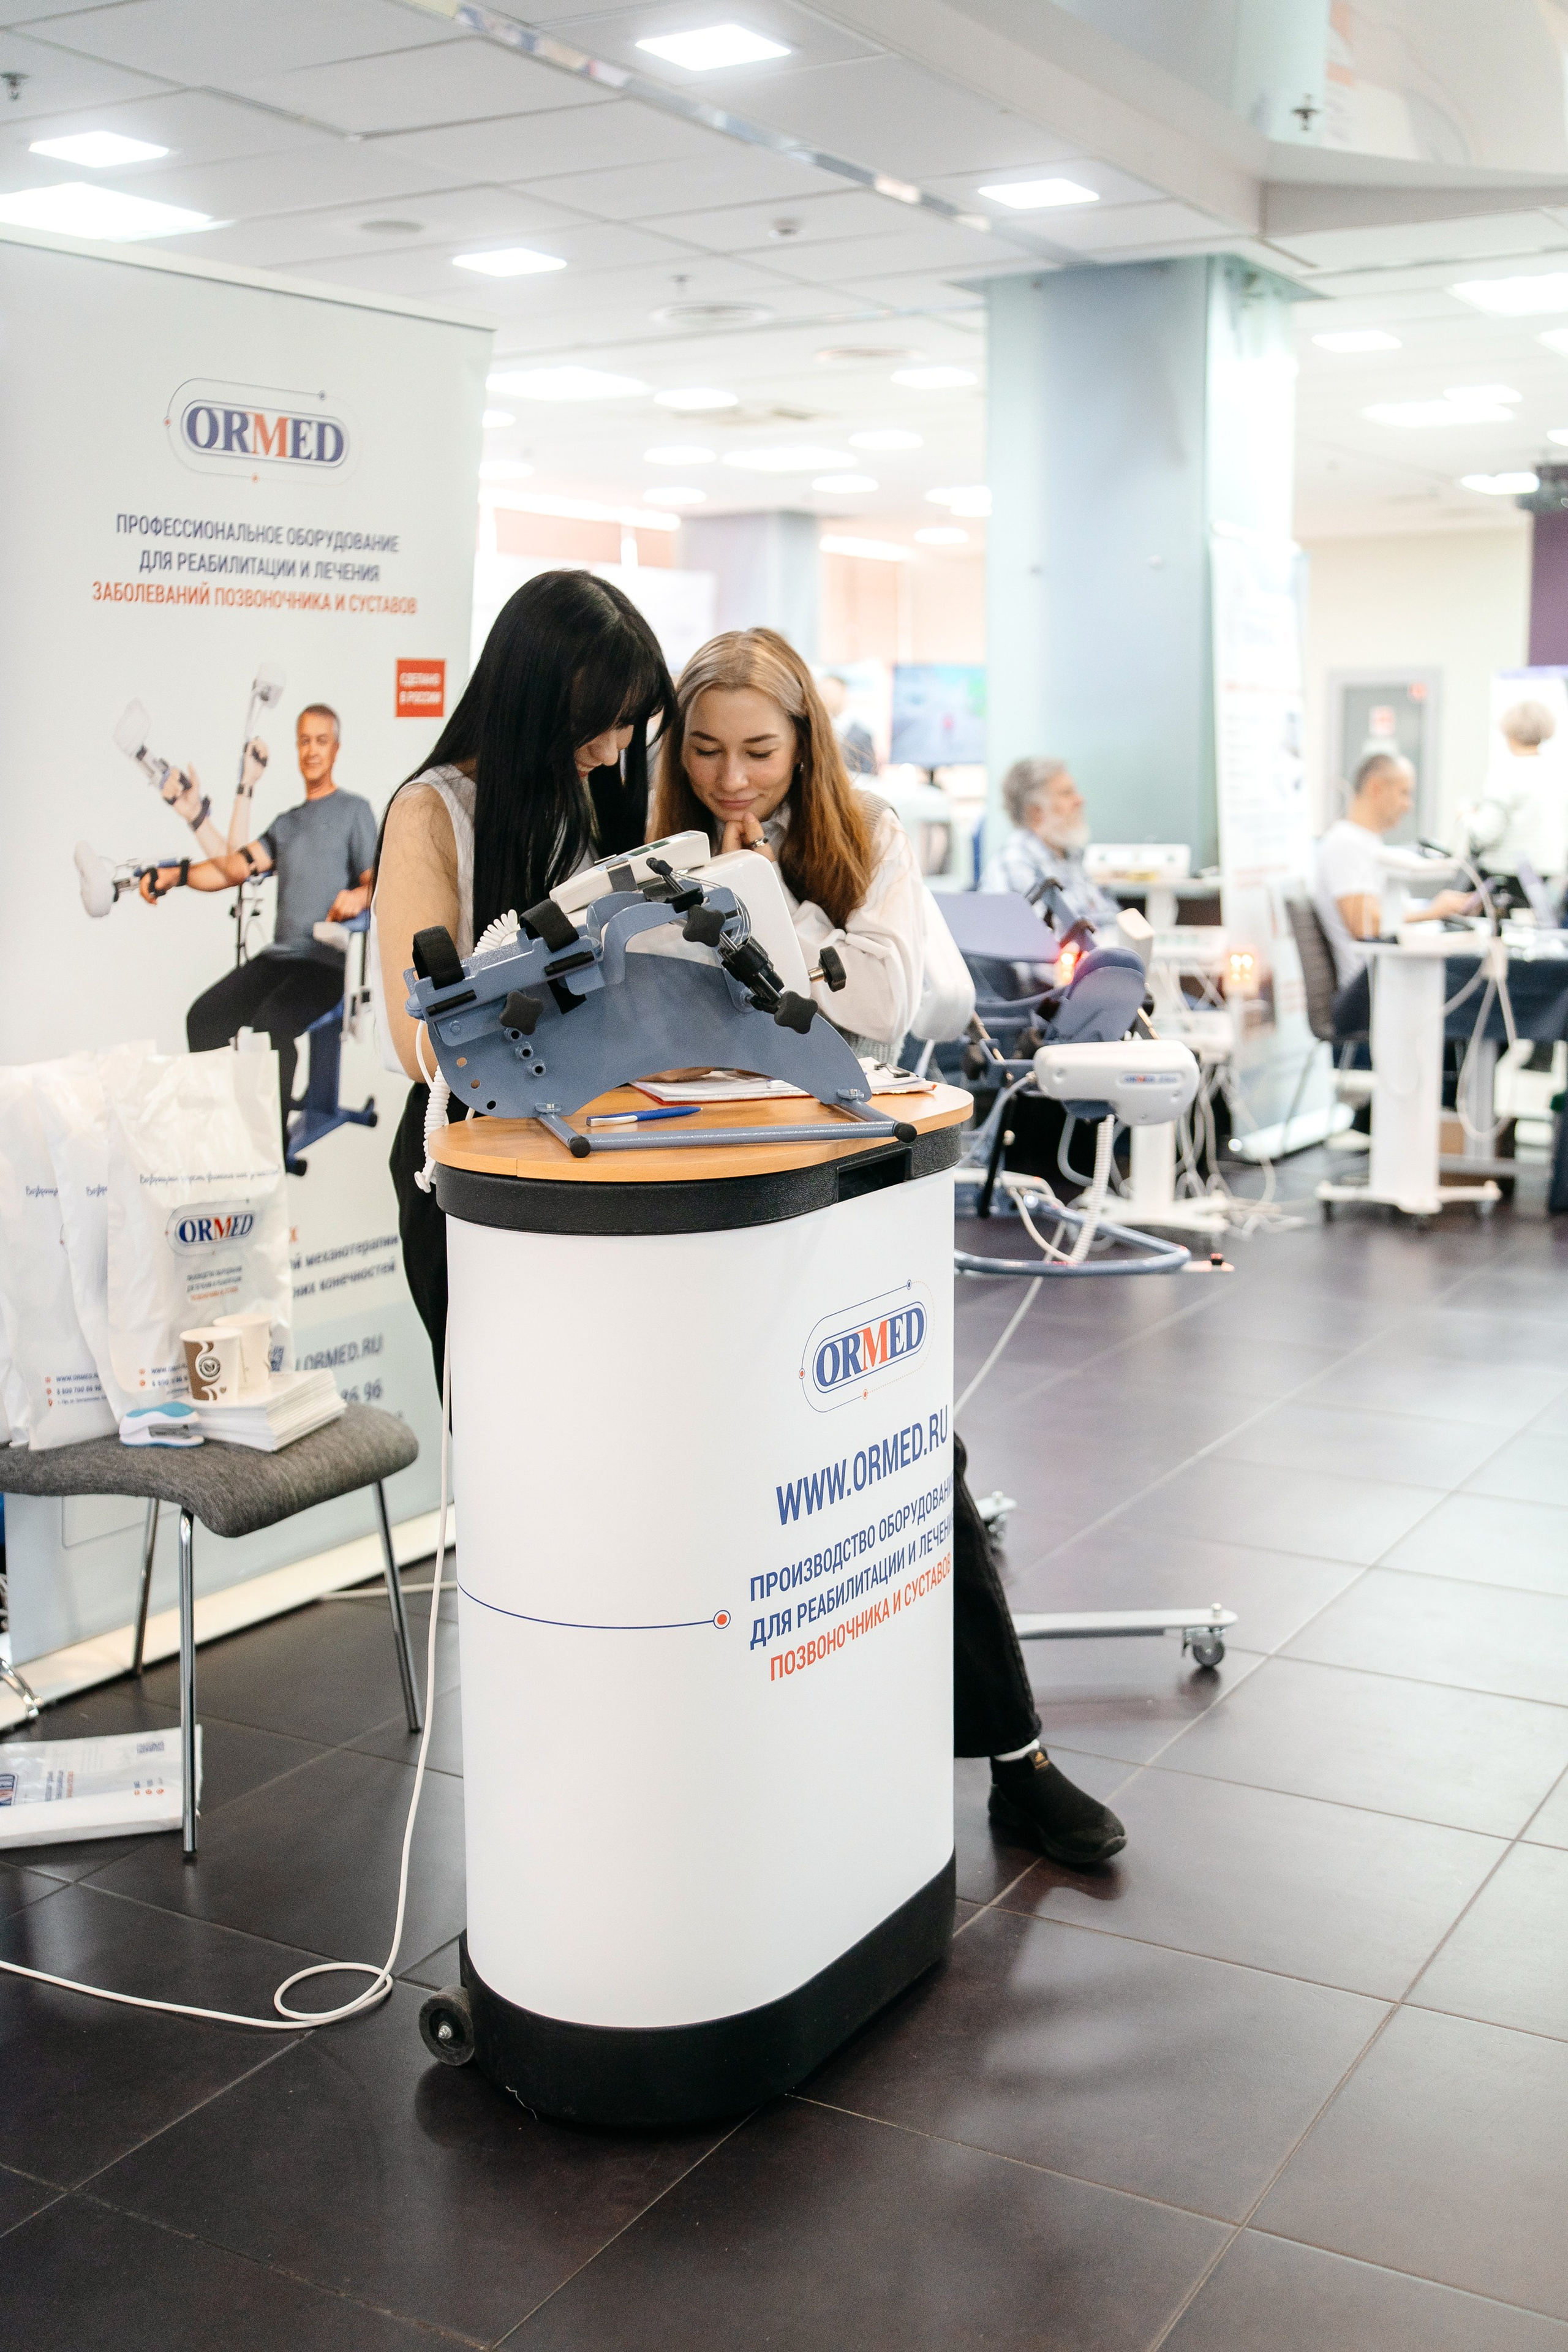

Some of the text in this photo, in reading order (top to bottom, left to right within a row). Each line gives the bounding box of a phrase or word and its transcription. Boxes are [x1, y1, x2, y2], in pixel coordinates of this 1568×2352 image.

[186, 405, 344, 462] ORMED
[116, 513, 399, 552] ПРОФЕССИОНАЛЬНОЕ ОБОРУДОВАНИЕ
[139, 549, 380, 582] ДЛЯ РЕАБИЛИТАЦИИ И ЛЕЧЕНИЯ
[92, 580, 418, 614] ЗАБОЛЕВАНИЙ ПОЗВОНОЧНИКА И СУСТАВОВ
[179, 1213, 253, 1243] ORMED
[816, 1307, 924, 1387] ORMED
[775, 1404, 948, 1526] WWW.ORMED.RU
[750, 1525, 875, 1602] ПРОИЗВОДСТВО
[750, 1608, 792, 1651] ДЛЯ
[797, 1547, 905, 1629] РЕАБИЛИТАЦИИ
[908, 1540, 916, 1566] И
[771, 1551, 951, 1682] ПОЗВОНОЧНИКА И СУСТАВОВ
